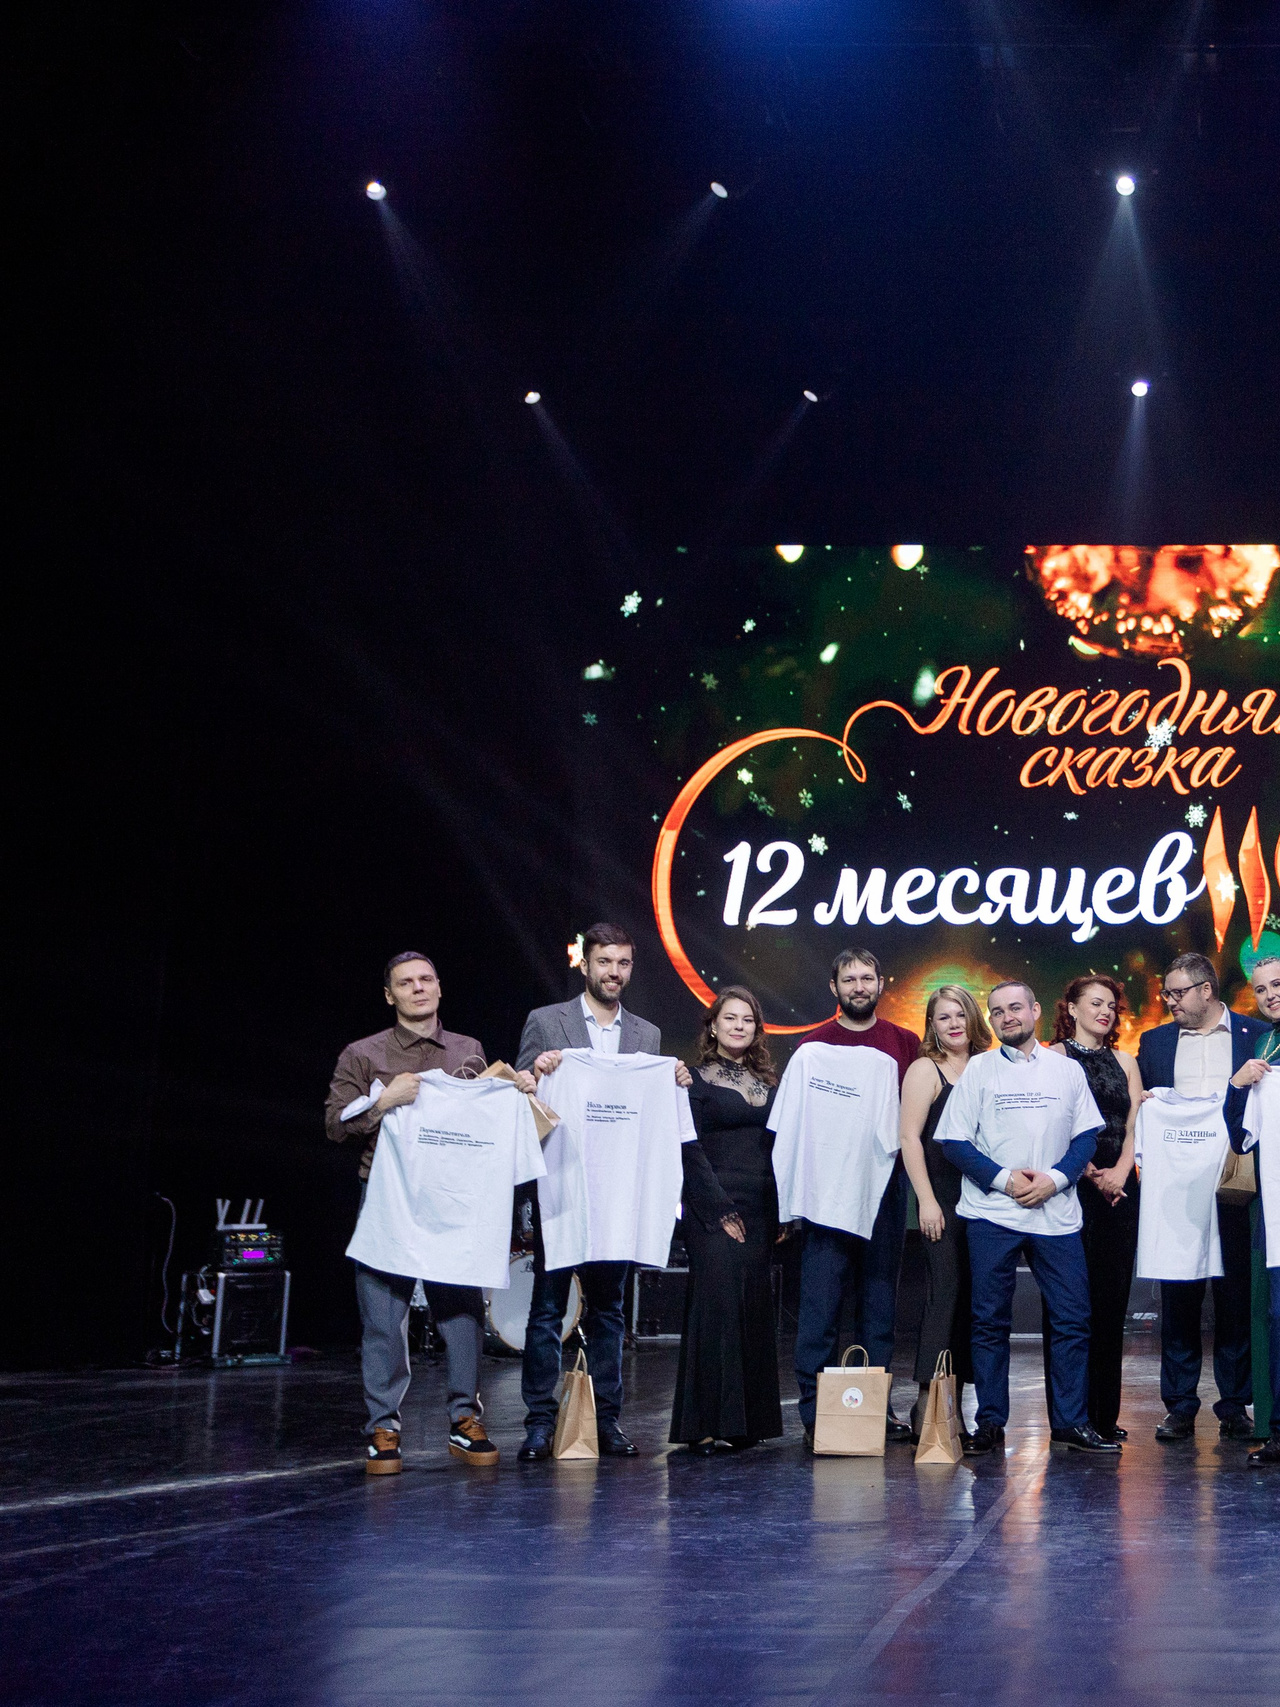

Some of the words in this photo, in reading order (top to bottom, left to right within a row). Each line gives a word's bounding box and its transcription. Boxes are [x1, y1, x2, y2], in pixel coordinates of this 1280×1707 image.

[1019, 746, 1243, 796] сказка
[722, 840, 805, 927] 12
[813, 831, 1207, 944] месяцев
